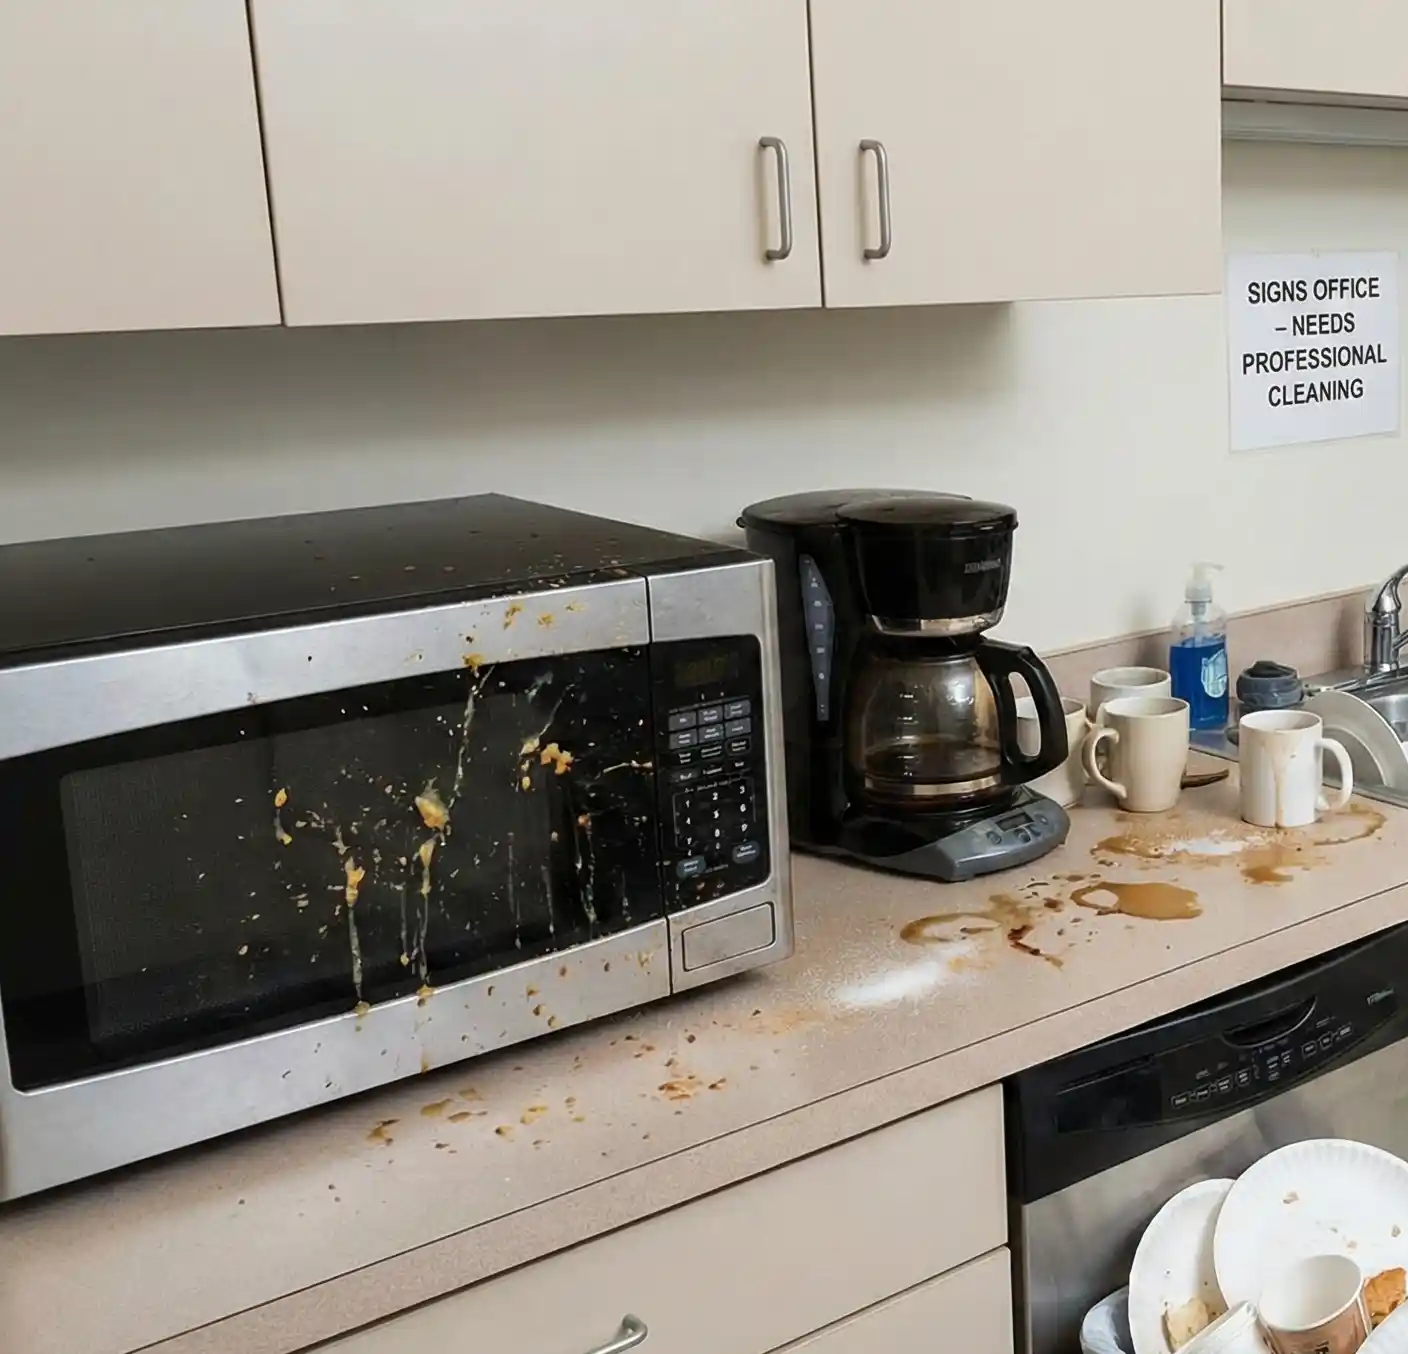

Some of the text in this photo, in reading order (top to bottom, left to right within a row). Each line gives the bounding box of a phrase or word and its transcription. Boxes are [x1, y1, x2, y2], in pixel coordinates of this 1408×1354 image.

[1248, 277, 1380, 304] SIGNS OFFICE
[1292, 312, 1356, 336] NEEDS
[1242, 344, 1388, 375] PROFESSIONAL
[1268, 378, 1364, 407] CLEANING
